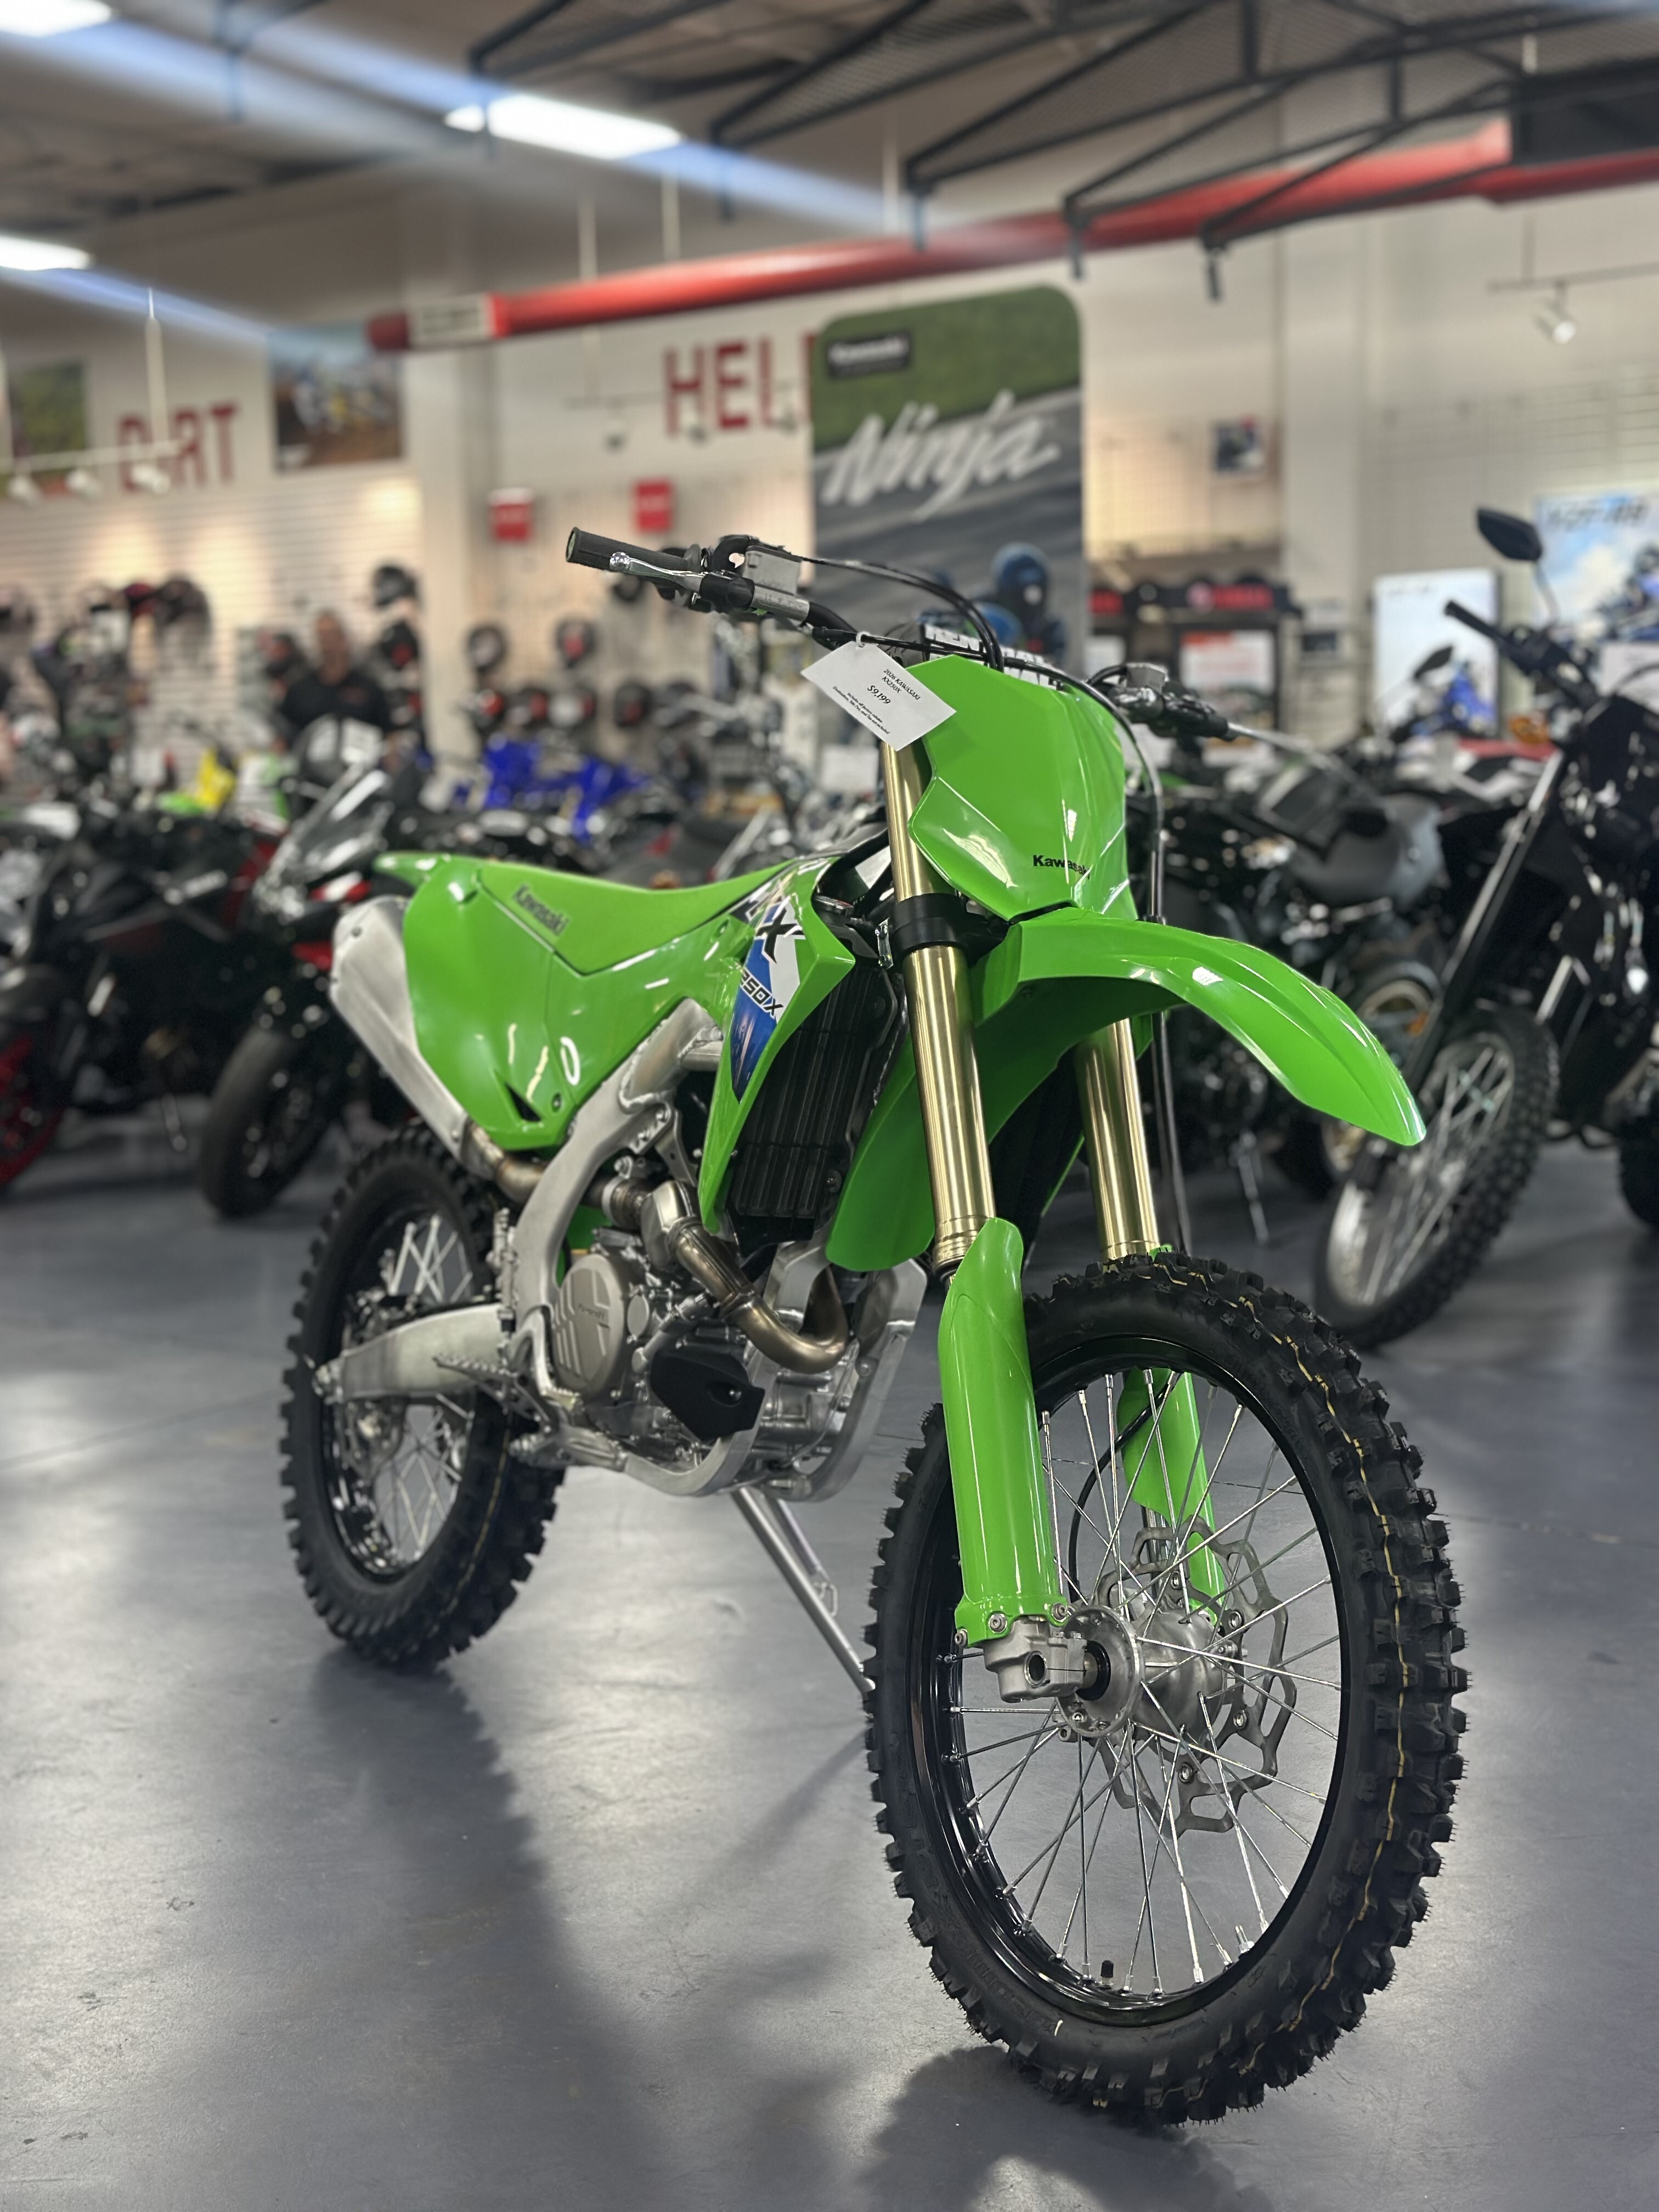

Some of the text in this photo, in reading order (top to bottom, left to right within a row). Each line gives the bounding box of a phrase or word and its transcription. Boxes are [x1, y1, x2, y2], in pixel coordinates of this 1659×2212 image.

[665, 333, 816, 437] HEL
[118, 402, 237, 492] DRT
[820, 388, 1061, 522] Ninja
[867, 685, 891, 704] $9,199
[882, 676, 902, 693] KX250X
[883, 669, 921, 700] 2026 KAWASAKI
